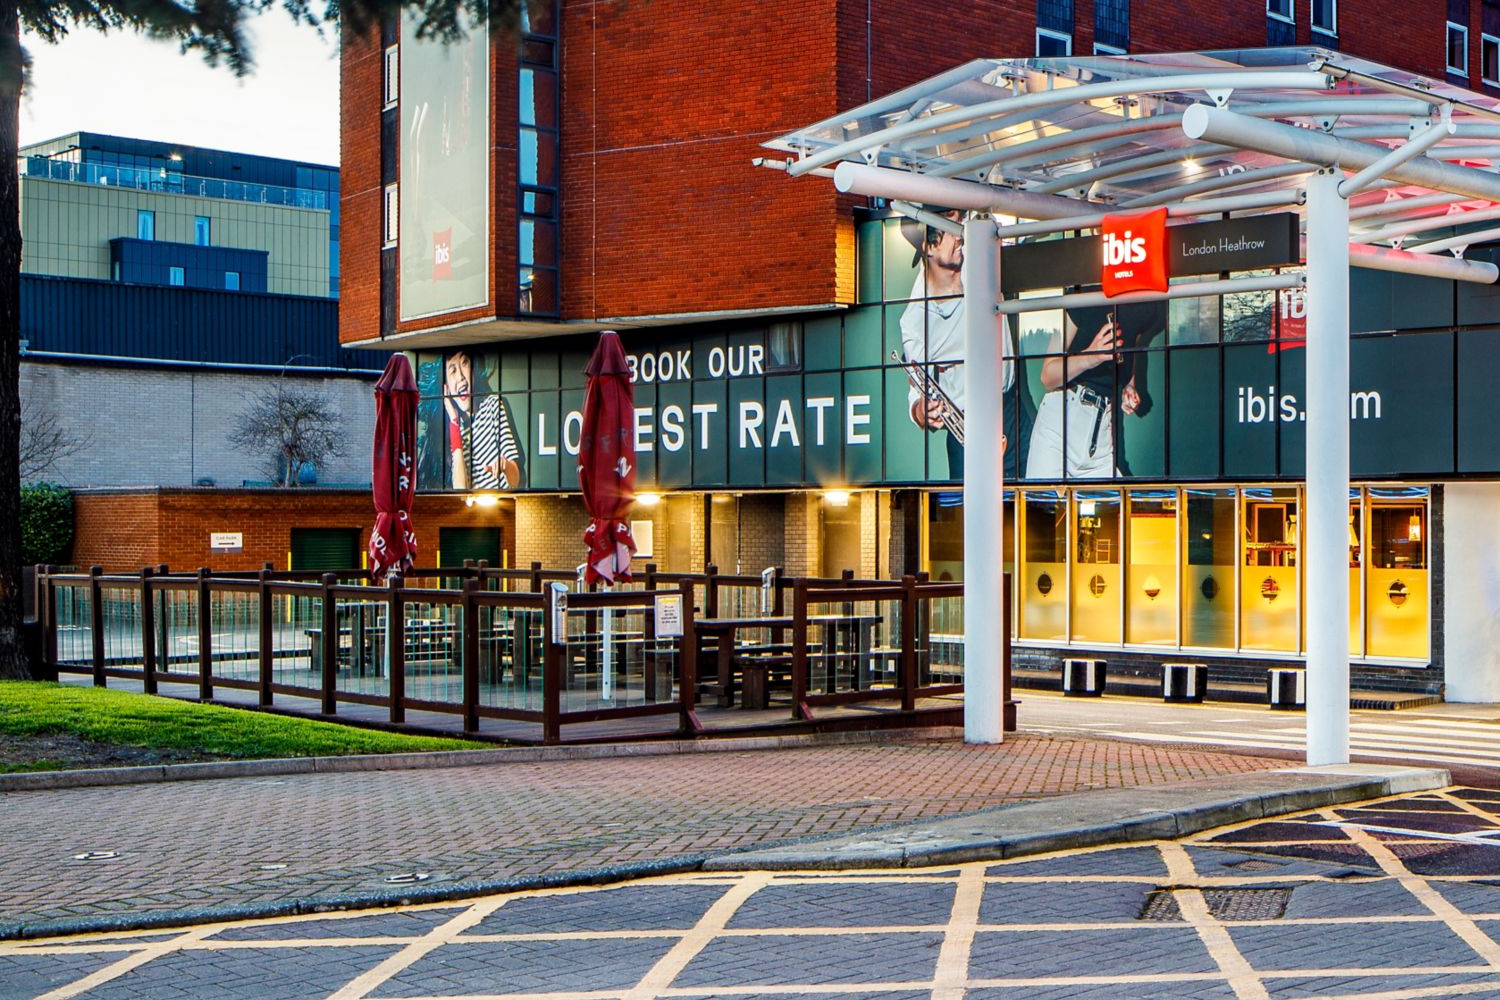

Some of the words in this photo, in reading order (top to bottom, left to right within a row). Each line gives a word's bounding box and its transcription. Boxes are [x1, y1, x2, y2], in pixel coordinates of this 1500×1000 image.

[435, 242, 450, 265] ibis
[1102, 230, 1147, 267] ibis
[1182, 239, 1217, 257] London
[1219, 235, 1265, 252] Heathrow
[1114, 270, 1133, 279] HOTELS
[626, 350, 691, 383] BOOK
[708, 345, 764, 378] OUR
[1238, 386, 1381, 423] ibis.m
[538, 403, 717, 455] LOEST
[739, 394, 871, 449] RATE
